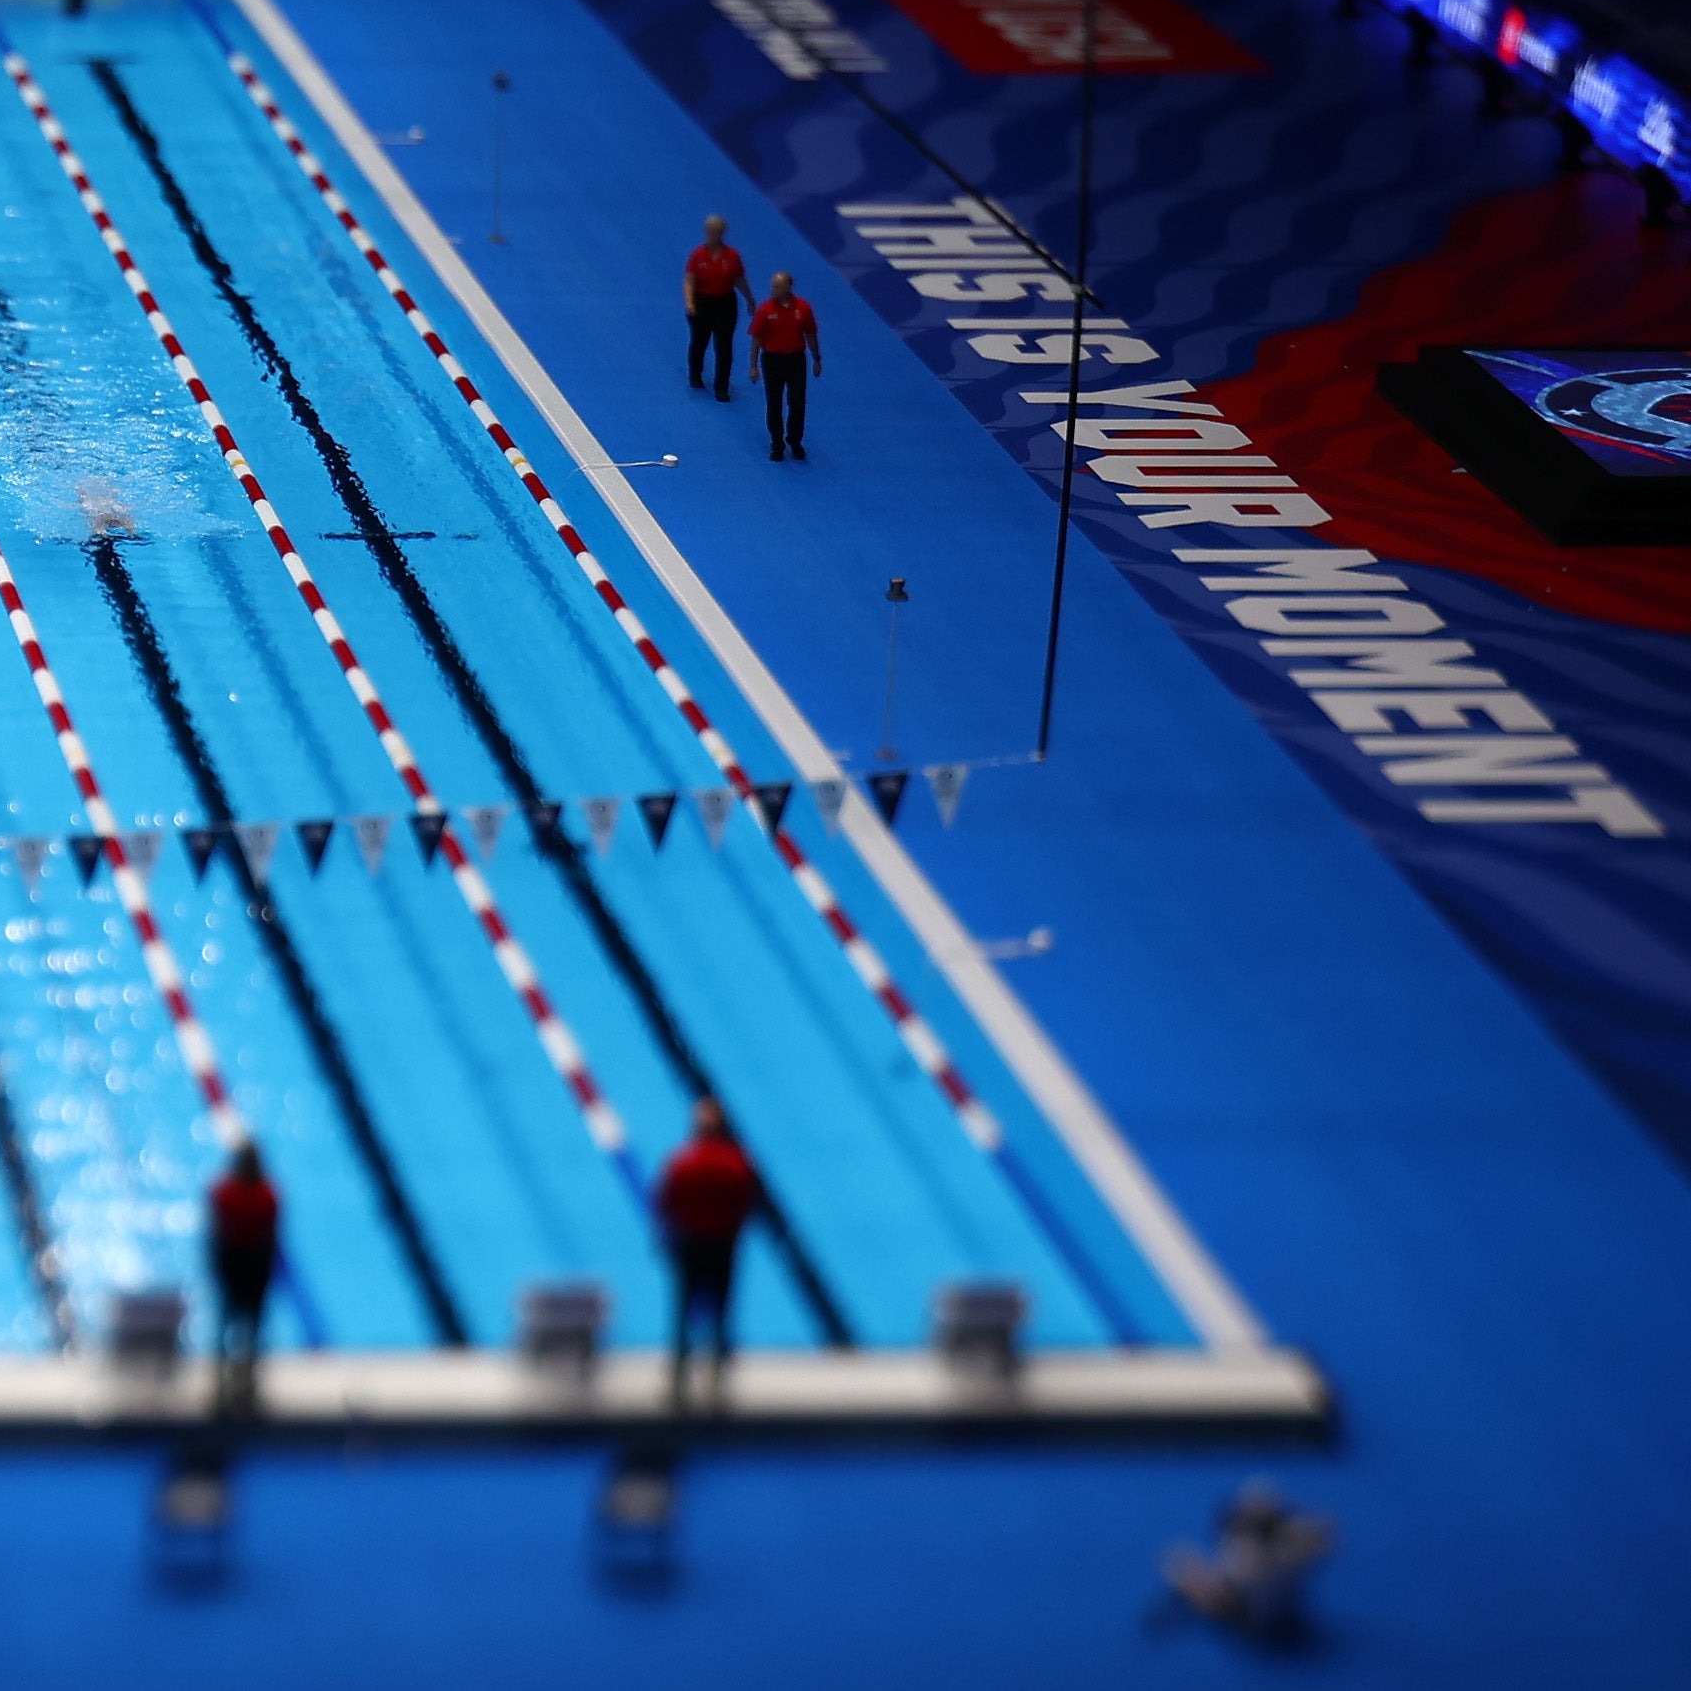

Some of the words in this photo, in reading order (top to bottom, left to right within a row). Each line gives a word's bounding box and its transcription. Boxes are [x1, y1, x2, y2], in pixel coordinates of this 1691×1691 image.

[835, 195, 1090, 302] THIS
[946, 318, 1160, 365] IS
[1018, 379, 1333, 530] YOUR
[1170, 548, 1666, 839] MOMENT
